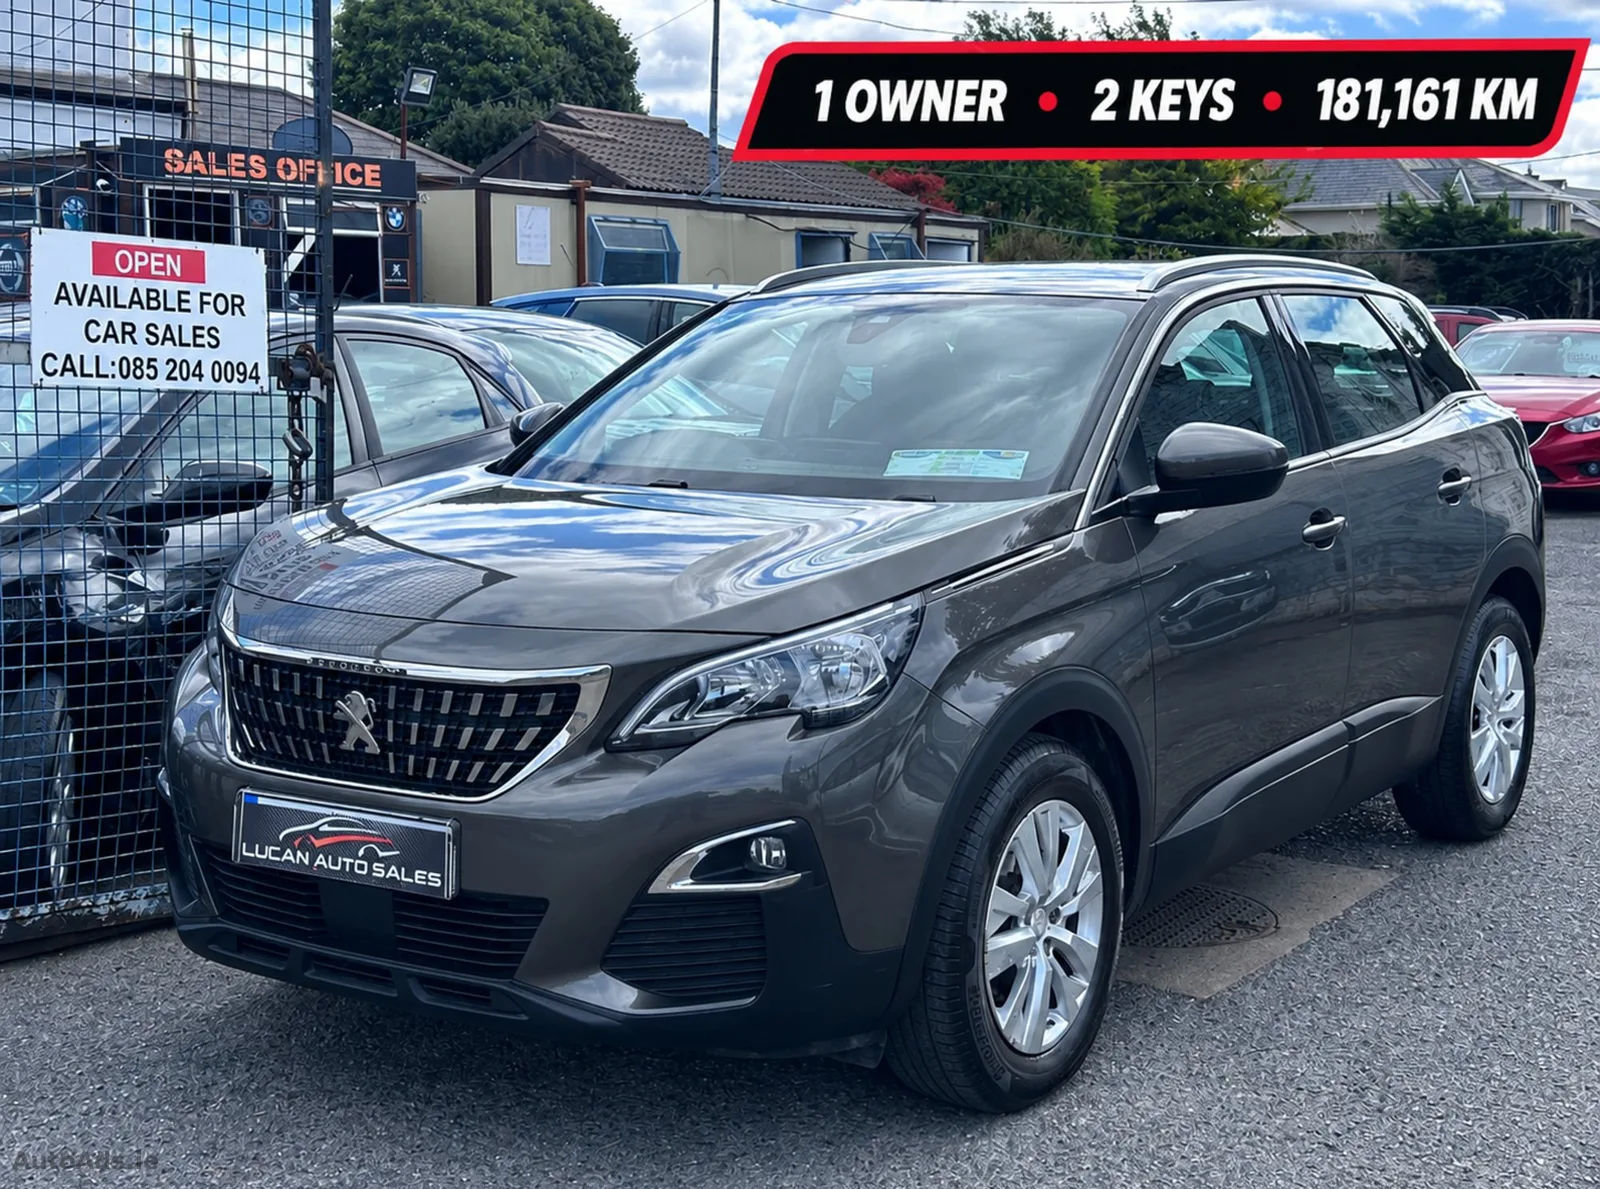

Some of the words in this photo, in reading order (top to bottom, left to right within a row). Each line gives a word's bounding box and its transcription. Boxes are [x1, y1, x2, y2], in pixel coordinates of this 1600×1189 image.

[164, 148, 267, 179] SALES
[114, 249, 182, 278] OPEN
[54, 281, 192, 314] AVAILABLE
[199, 291, 246, 317] FOR
[84, 319, 138, 345] CAR
[145, 322, 221, 349] SALES
[40, 352, 158, 382] CALL:085
[165, 358, 204, 382] 204
[211, 360, 261, 385] 0094
[242, 842, 310, 866] LUCAN
[314, 853, 368, 876] AUTO
[372, 863, 442, 888] SALES
